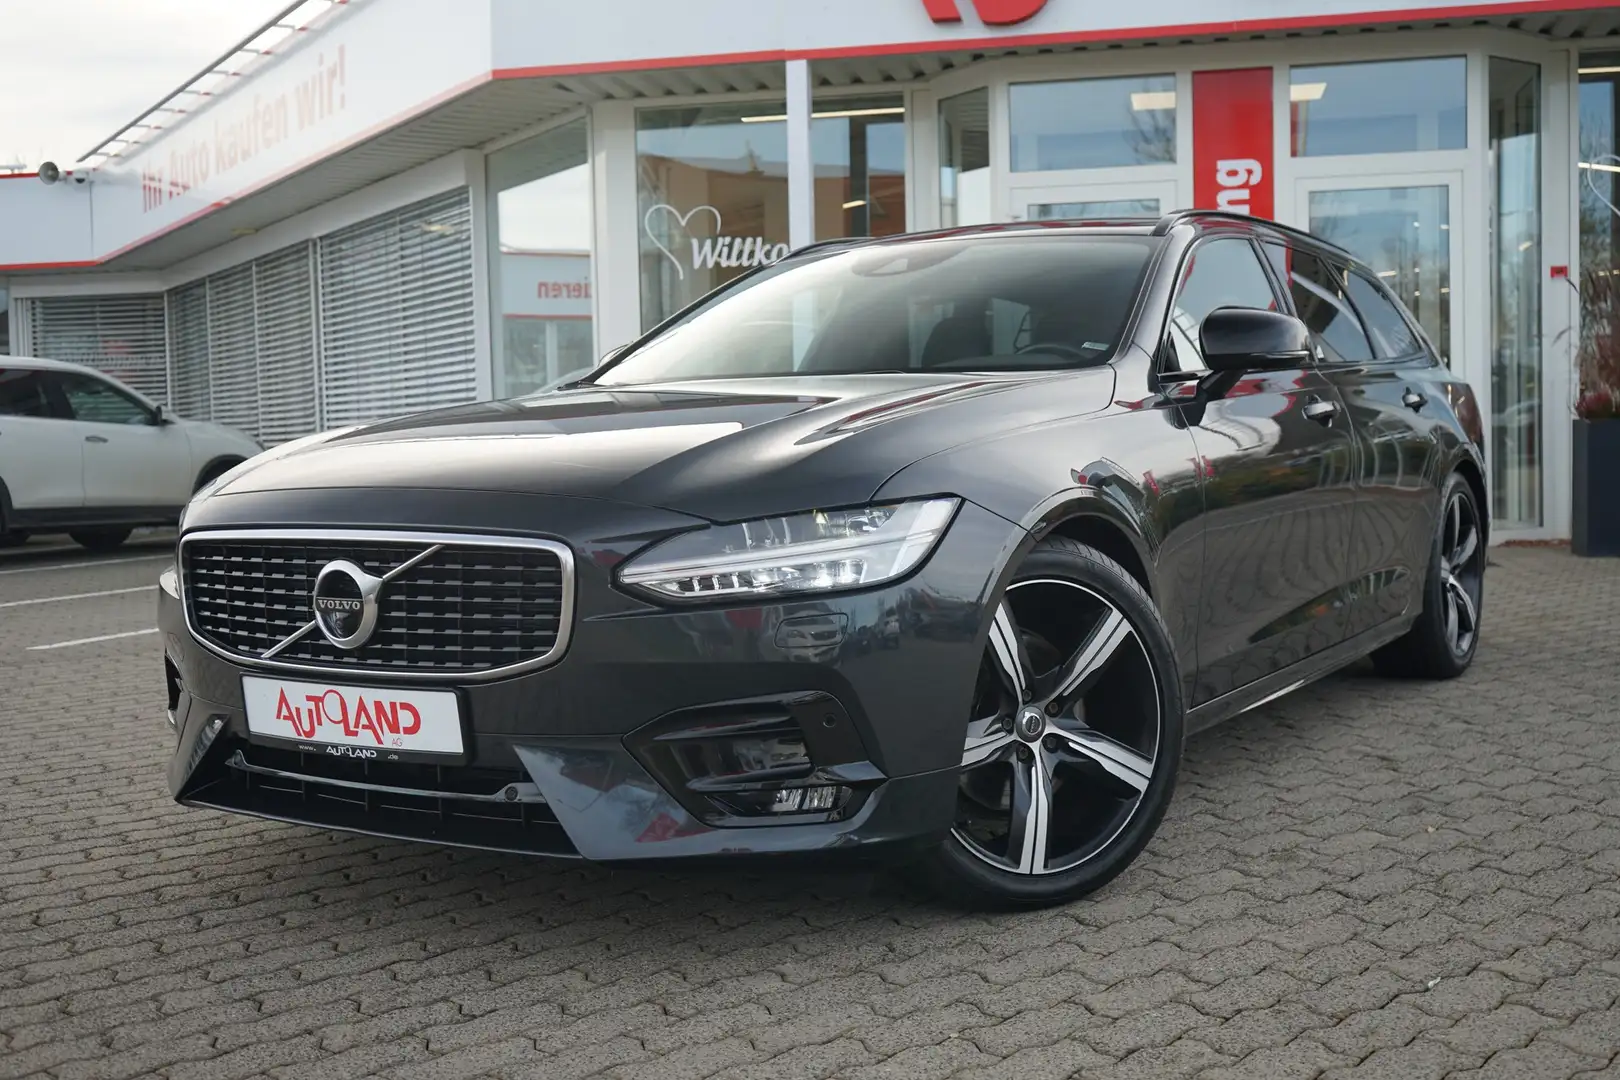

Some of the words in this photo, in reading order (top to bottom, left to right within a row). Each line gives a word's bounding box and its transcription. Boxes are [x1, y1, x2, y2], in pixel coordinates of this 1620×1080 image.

[214, 94, 289, 176] kaufen
[295, 44, 346, 132] wir!
[317, 599, 361, 610] VOLVO
[275, 686, 421, 745] AUTOLAND
[391, 737, 403, 748] AG
